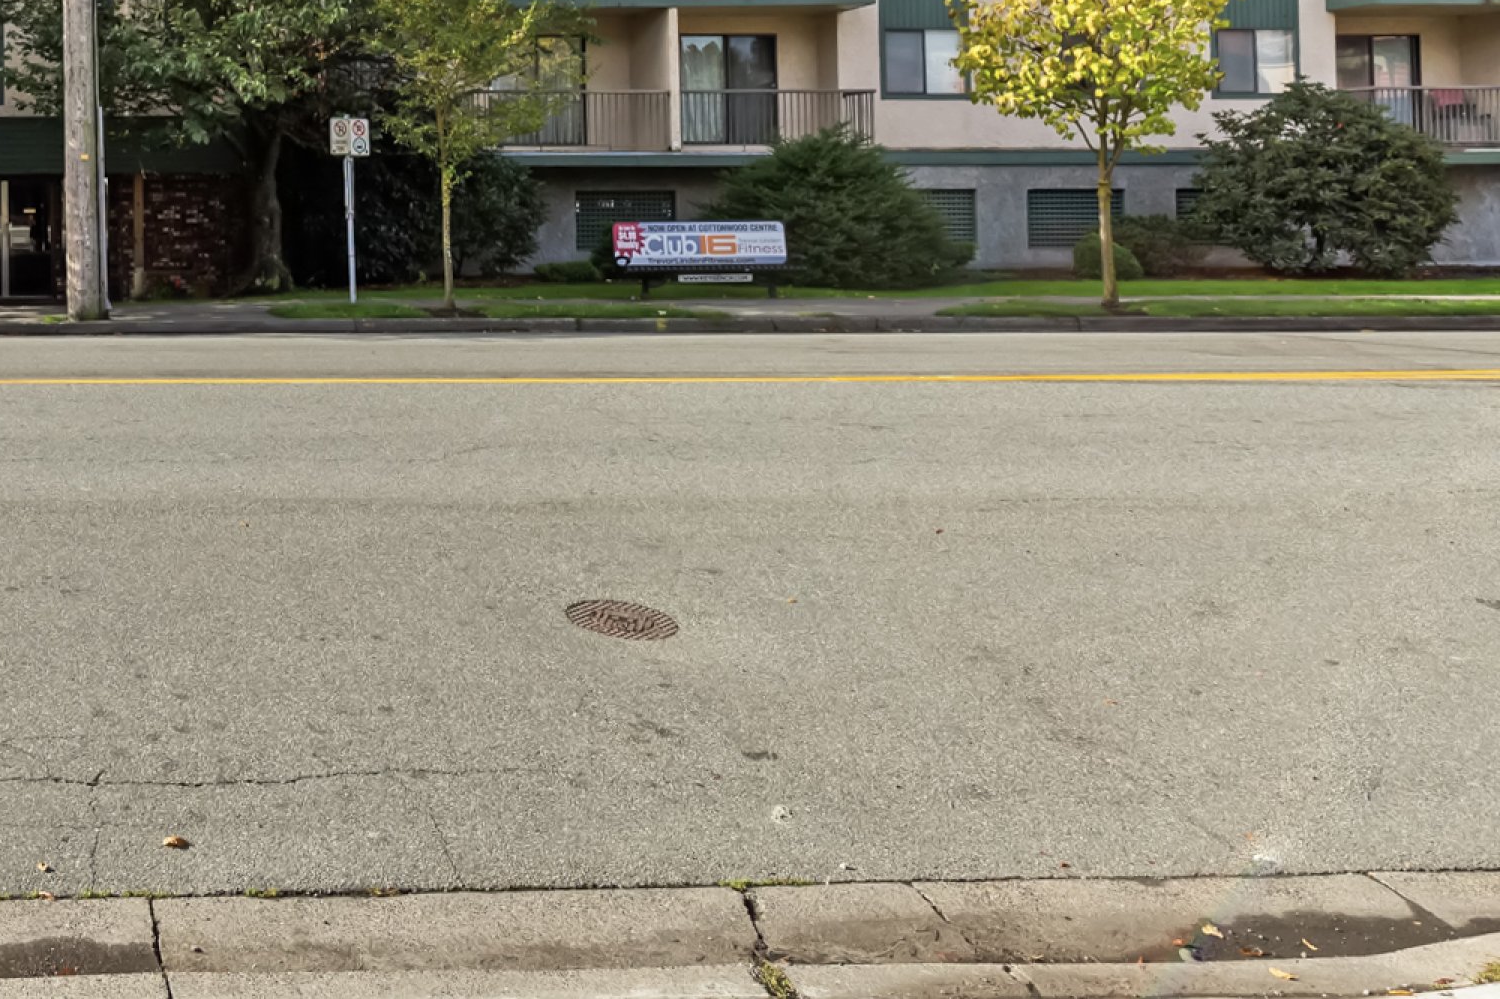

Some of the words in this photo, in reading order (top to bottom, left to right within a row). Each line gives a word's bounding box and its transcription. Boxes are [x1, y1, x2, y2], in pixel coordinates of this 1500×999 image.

[688, 224, 697, 232] AT
[699, 224, 748, 232] COTTONWOOD
[750, 224, 778, 232] CENTRE
[738, 244, 784, 254] Fitness
